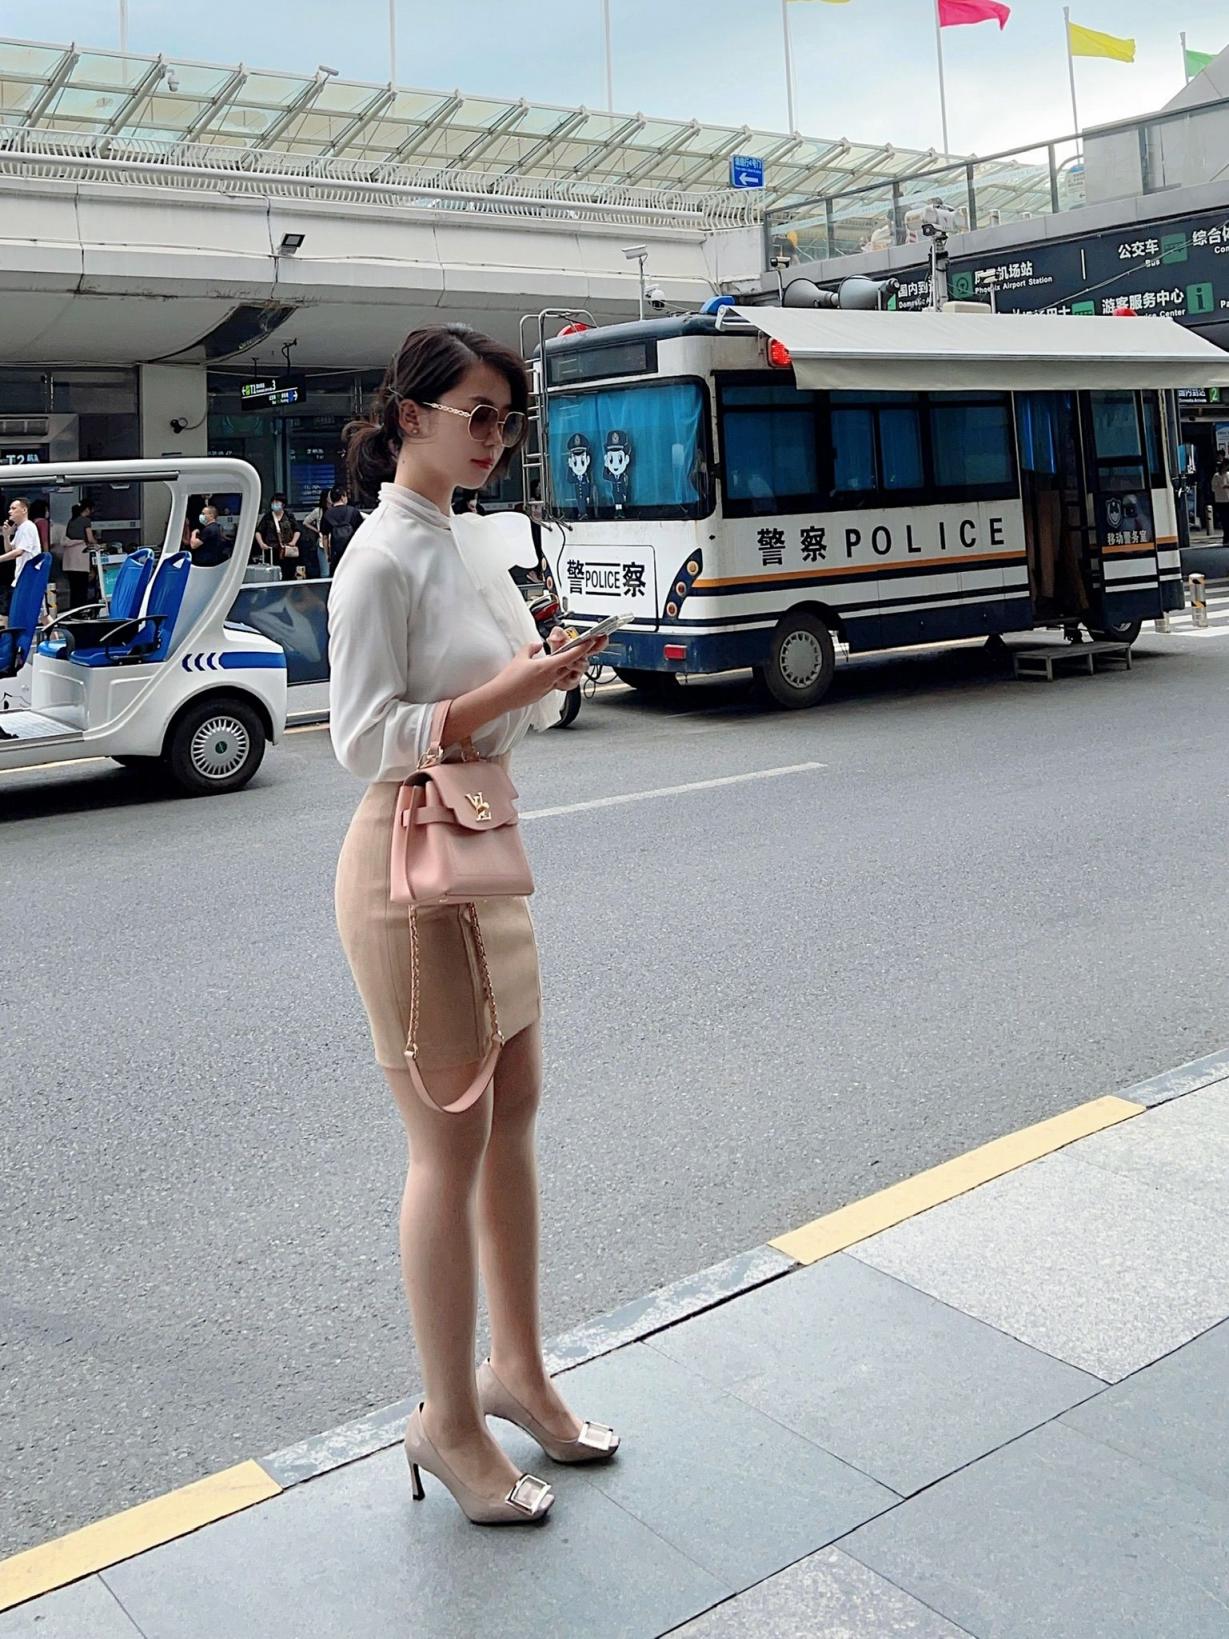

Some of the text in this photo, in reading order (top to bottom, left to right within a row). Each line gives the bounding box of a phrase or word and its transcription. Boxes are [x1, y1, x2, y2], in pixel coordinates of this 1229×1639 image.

[1118, 239, 1160, 259] 公交车
[975, 260, 1033, 285] 机场站
[1003, 279, 1026, 290] Airport
[1028, 277, 1053, 286] Station
[1102, 288, 1184, 315] 游客服务中心
[1160, 309, 1186, 319] Center
[757, 517, 1004, 566] 警察 POLICE
[567, 559, 646, 597] 警 POLICE 察
